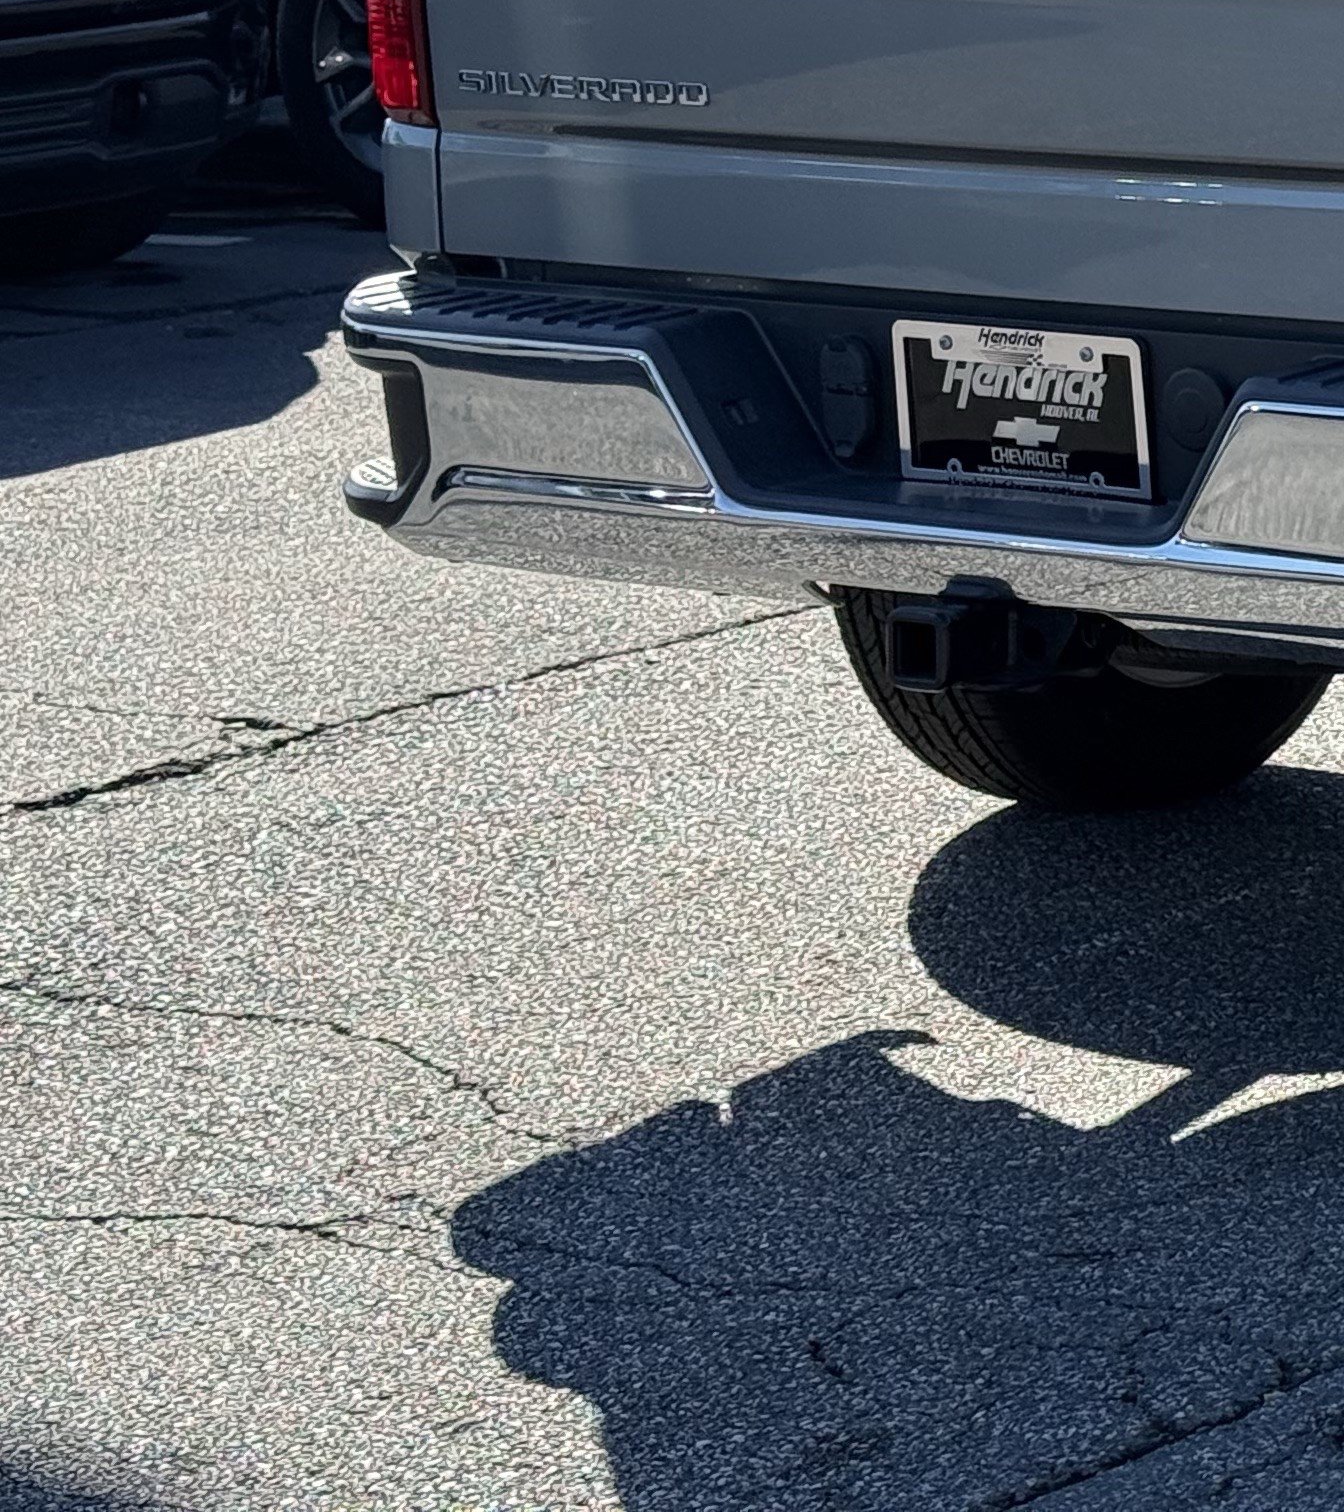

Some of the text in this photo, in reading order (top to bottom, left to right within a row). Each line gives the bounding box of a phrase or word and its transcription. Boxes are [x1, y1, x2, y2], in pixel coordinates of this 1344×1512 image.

[457, 68, 711, 108] SILVERADO
[977, 327, 1045, 348] Hendrick
[941, 358, 1108, 410] Hendrick
[991, 445, 1070, 470] CHEVROLET
